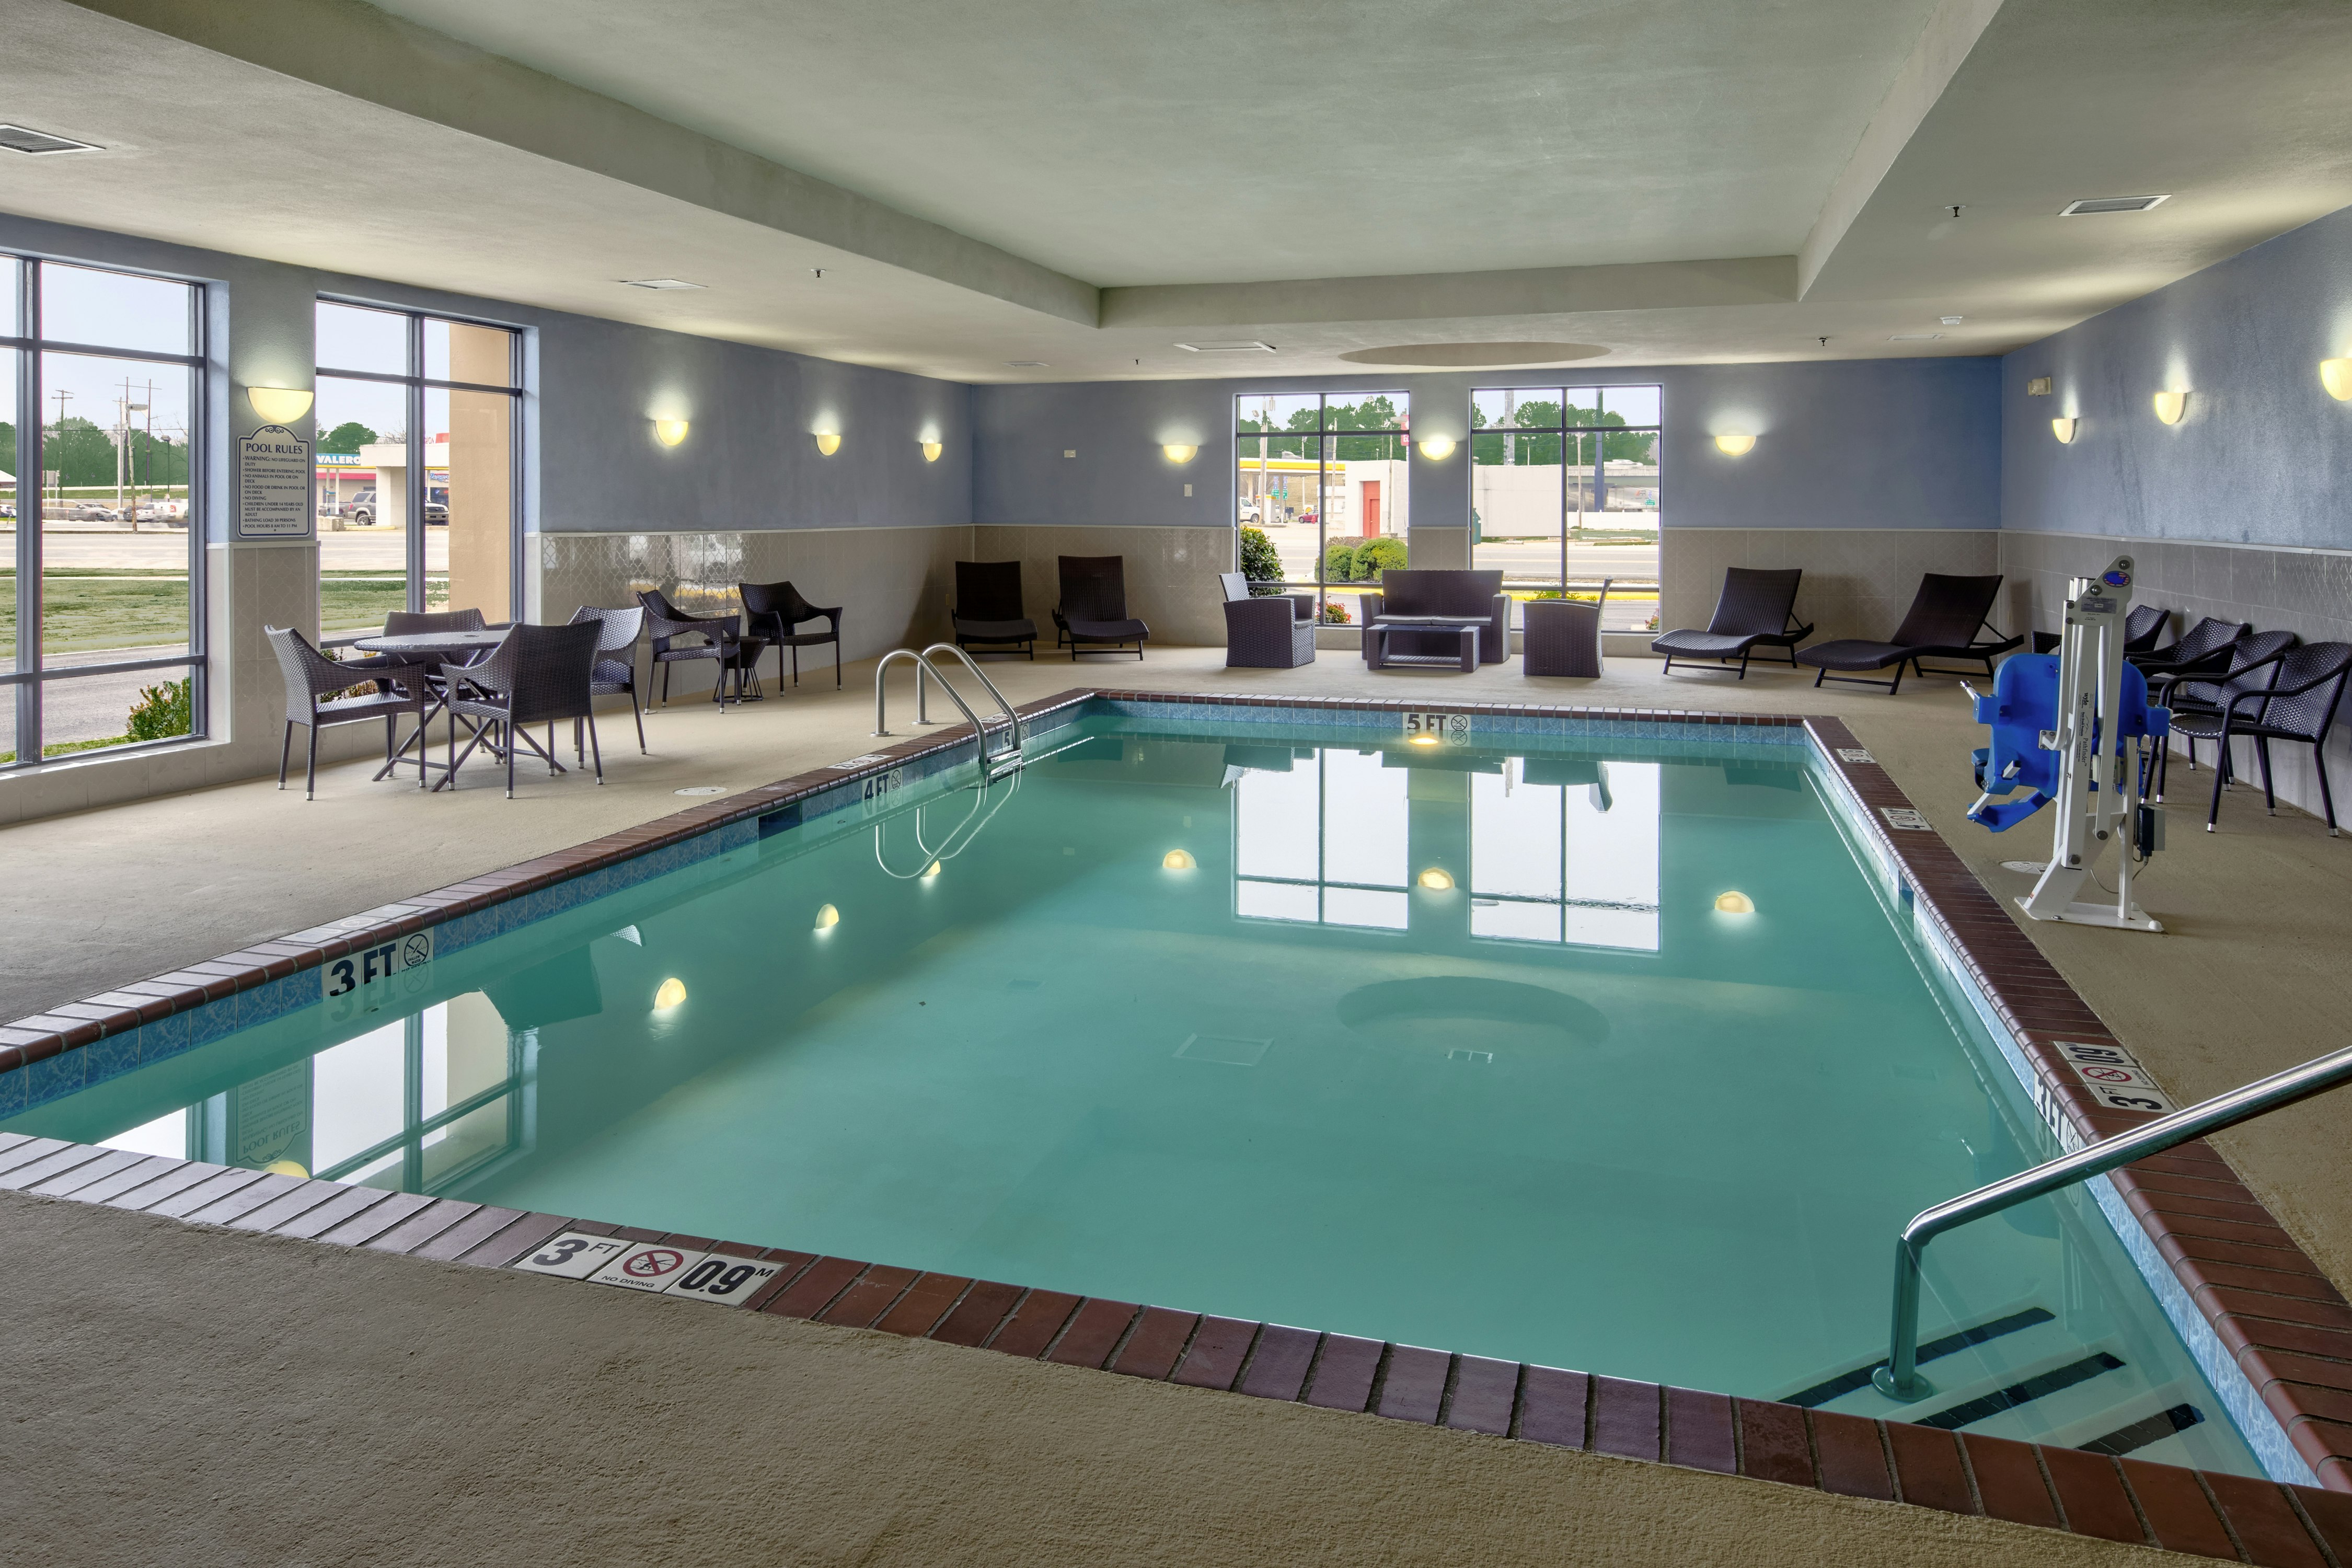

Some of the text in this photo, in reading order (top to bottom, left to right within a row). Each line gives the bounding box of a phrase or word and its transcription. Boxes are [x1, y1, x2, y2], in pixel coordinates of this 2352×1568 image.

[246, 443, 303, 454] POOL RULES
[316, 455, 361, 464] VALERO
[1407, 713, 1447, 731] 5 FT
[864, 773, 889, 800] 4 FT
[329, 942, 396, 997] 3 FT
[532, 1239, 621, 1266] 3 FT
[618, 1277, 655, 1288] DIVING
